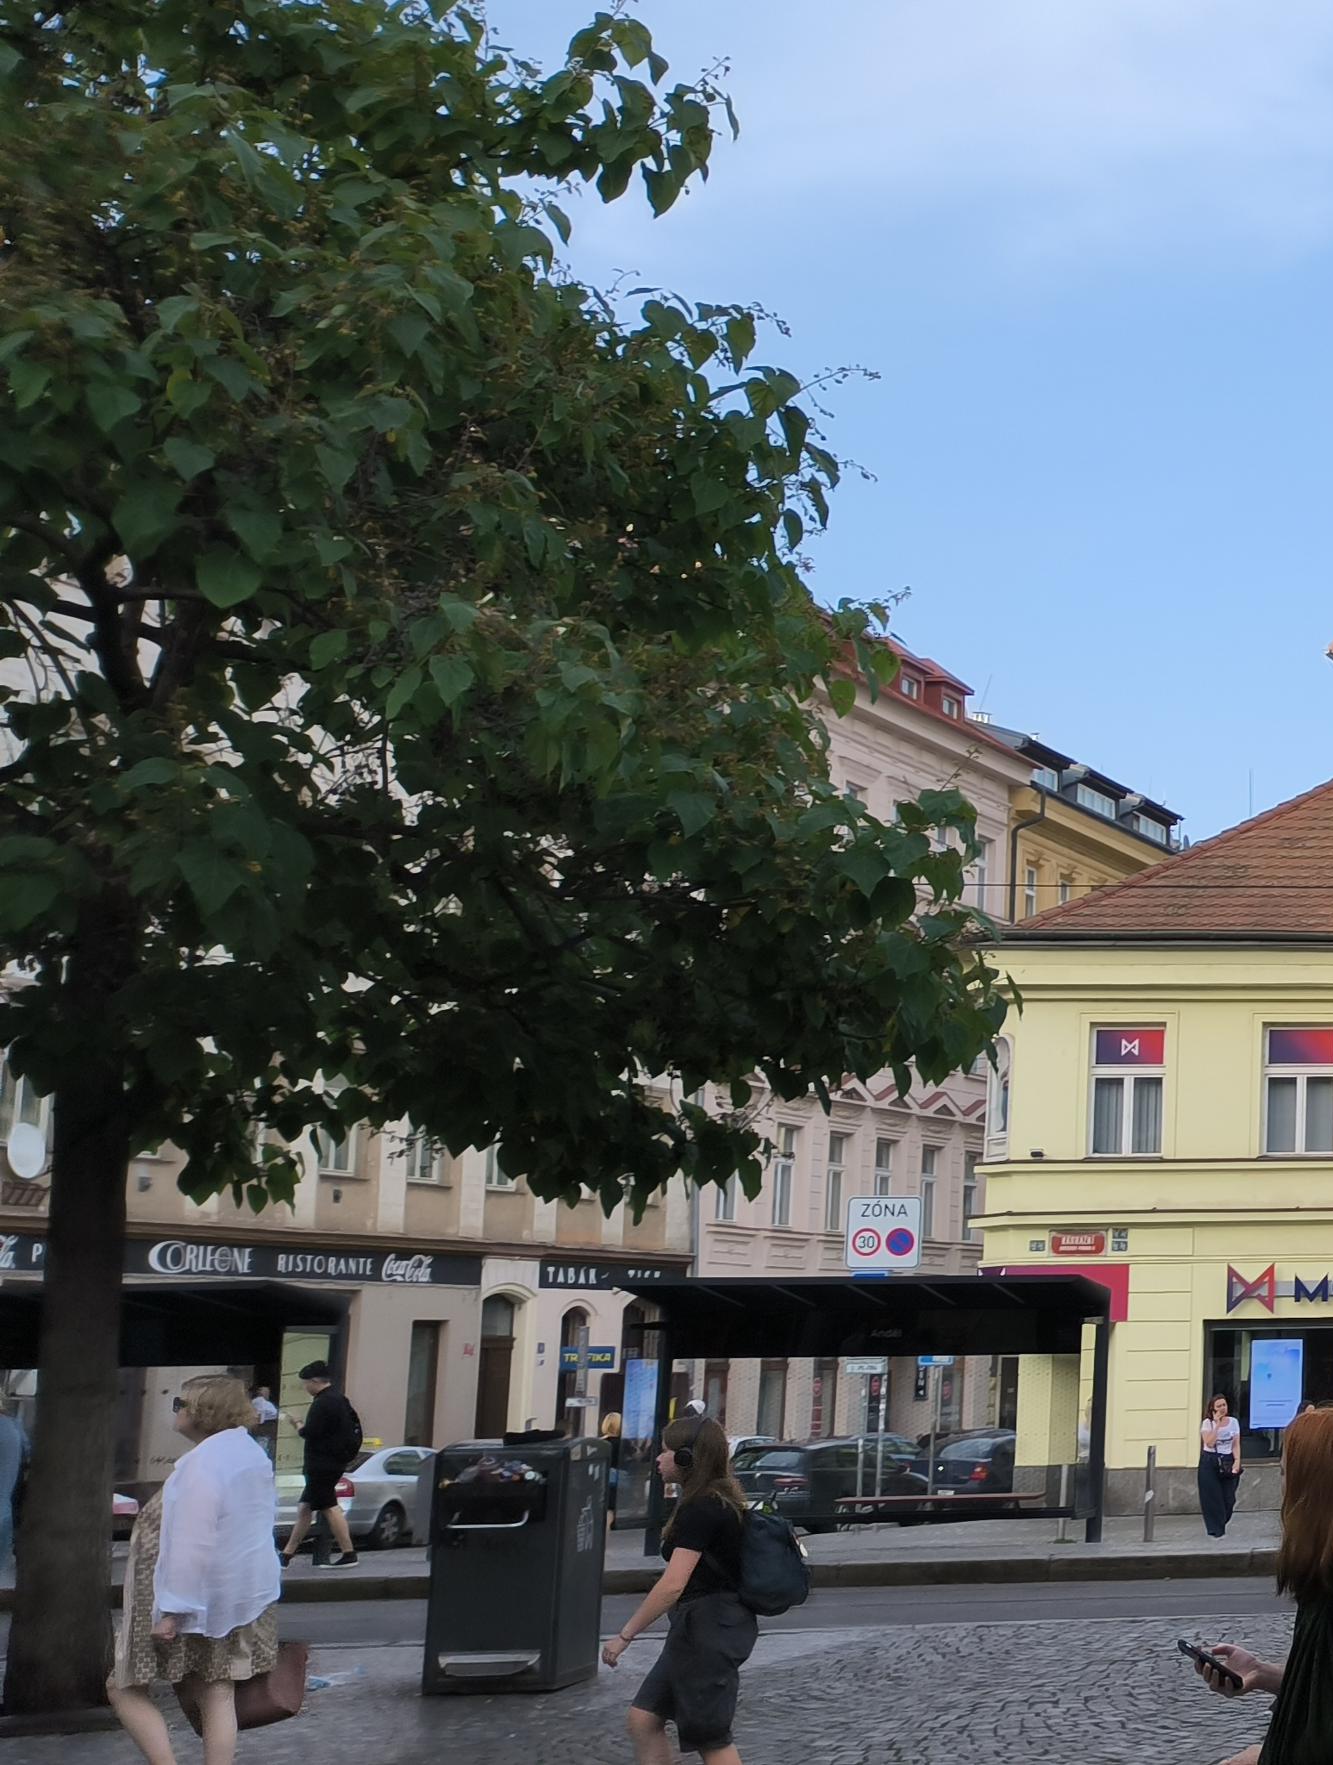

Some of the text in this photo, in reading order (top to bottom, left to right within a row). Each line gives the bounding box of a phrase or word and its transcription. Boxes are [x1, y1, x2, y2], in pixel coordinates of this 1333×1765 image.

[860, 1199, 909, 1218] ZÓNA
[857, 1235, 875, 1249] 30
[148, 1240, 253, 1274] CORLEONE
[276, 1253, 374, 1276] RISTORANTE
[546, 1266, 598, 1285] TABÁK
[563, 1352, 612, 1362] TRFIKA
